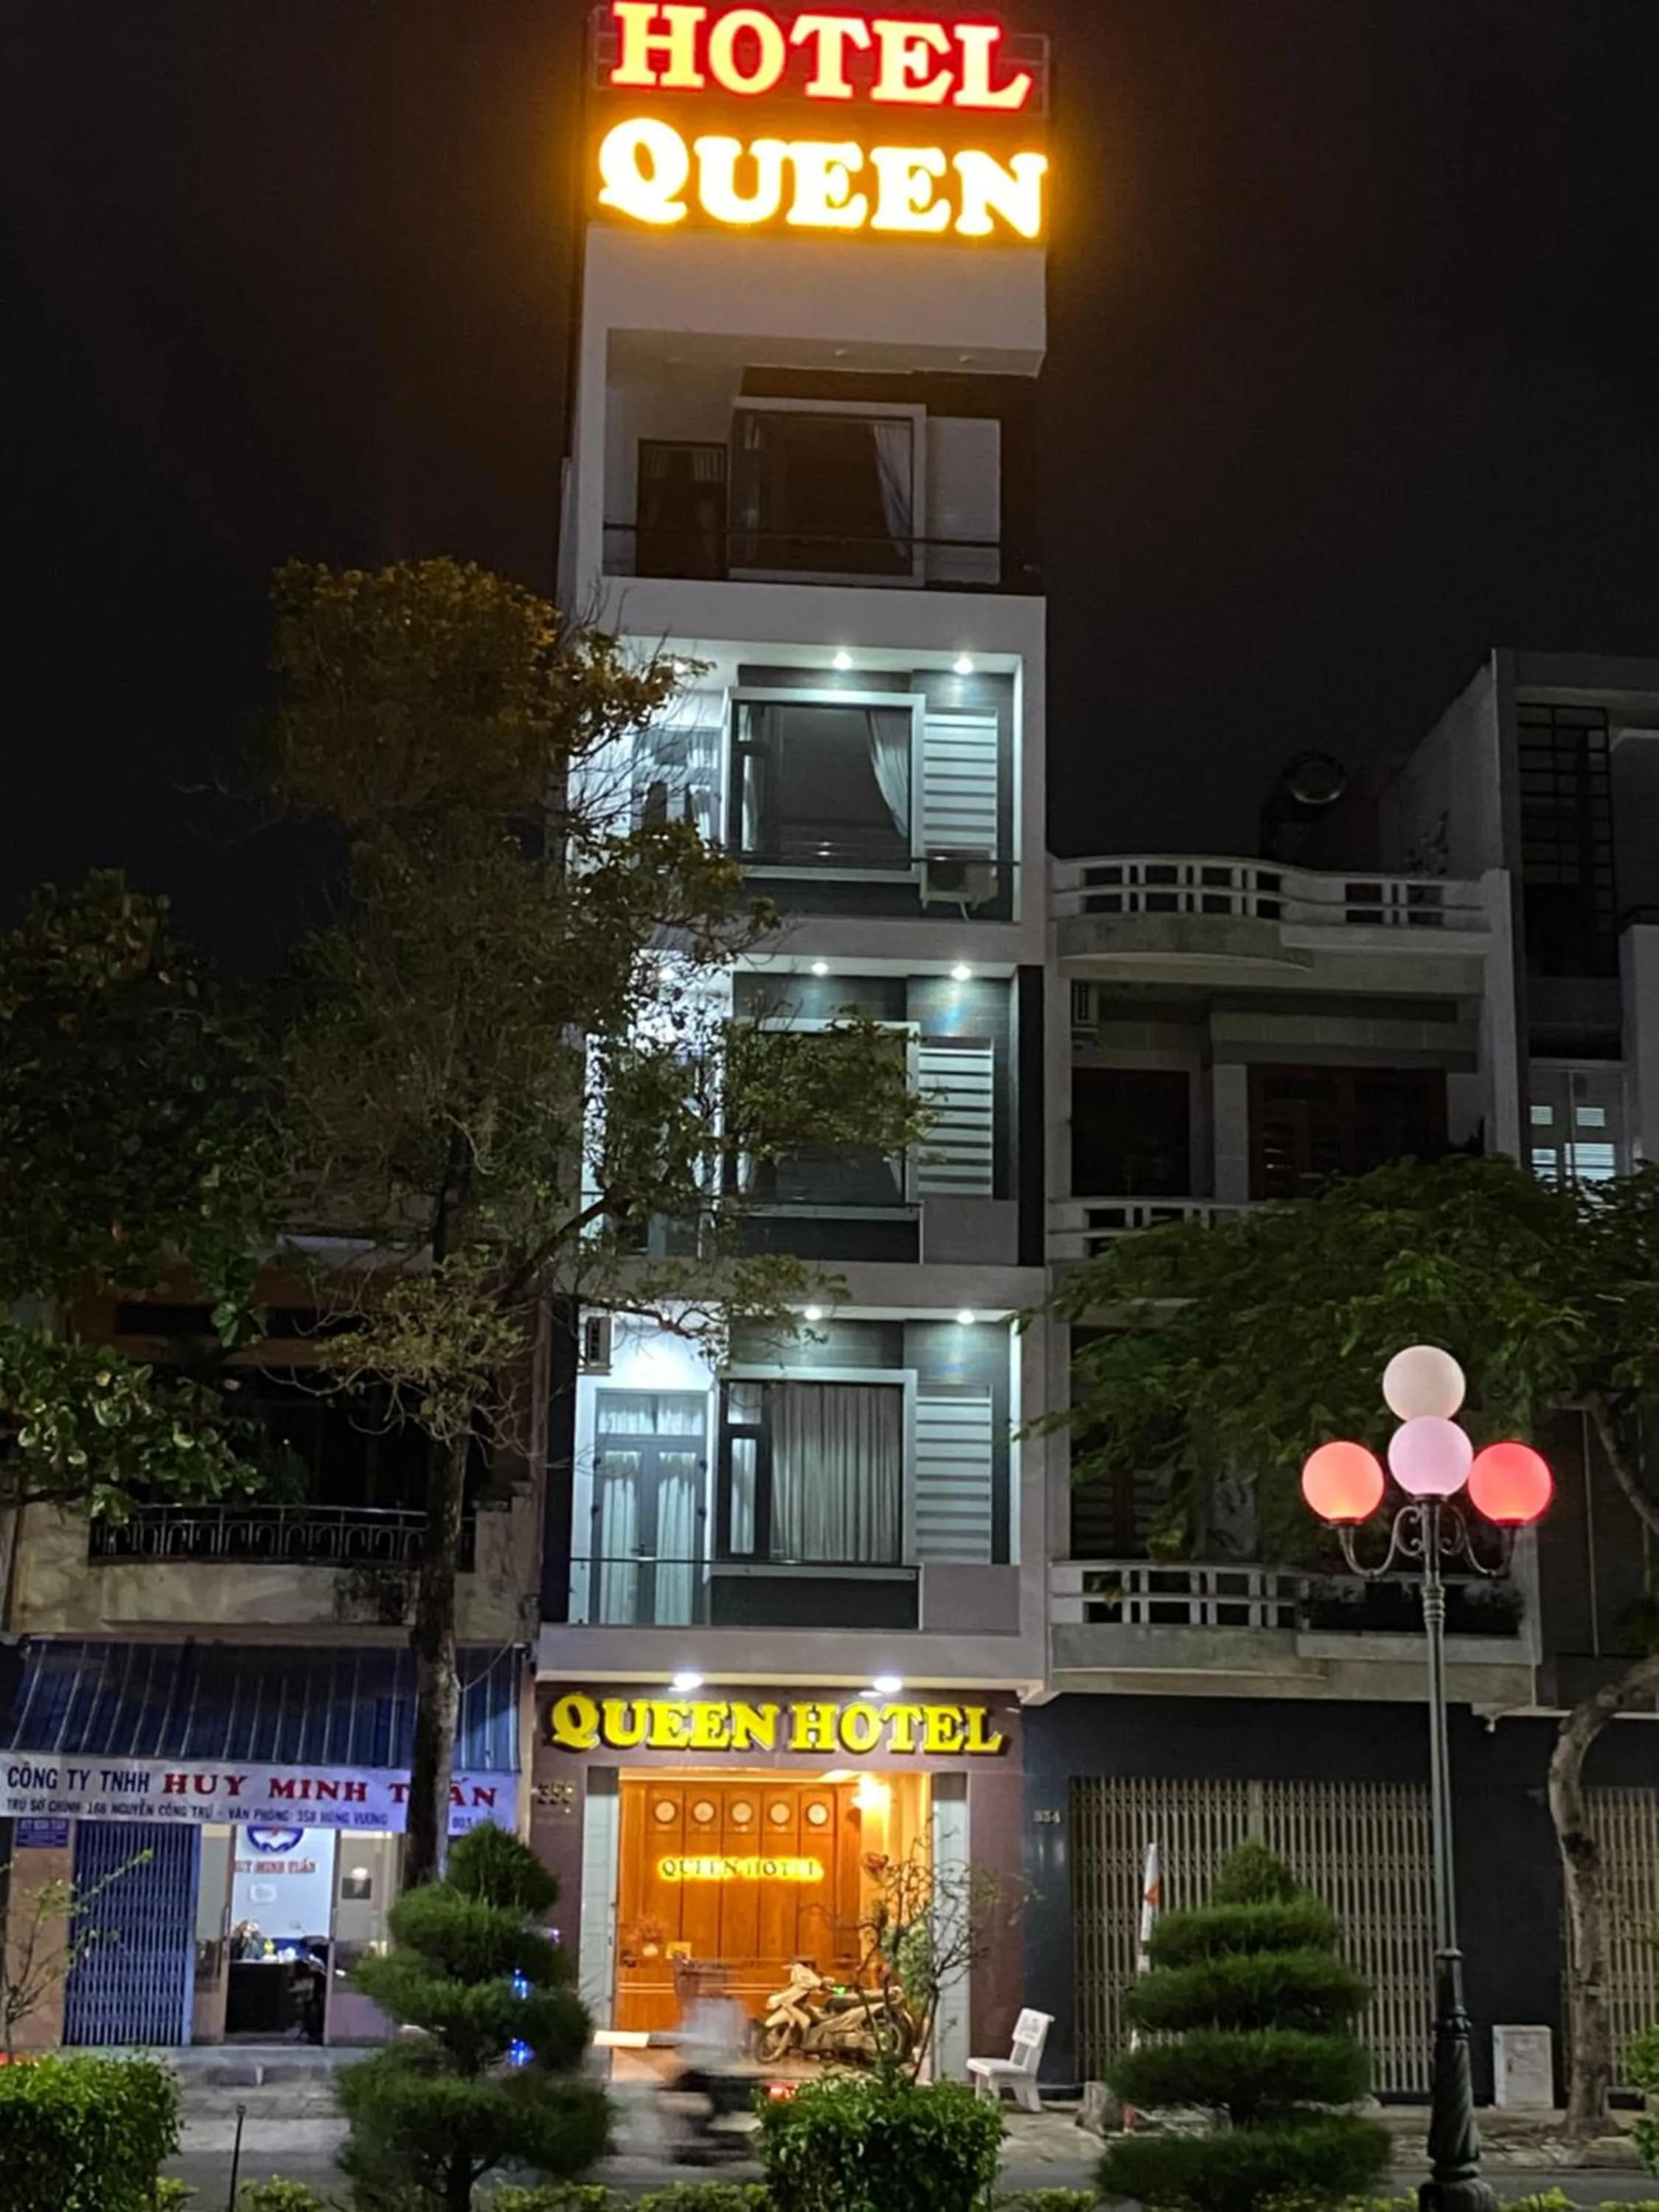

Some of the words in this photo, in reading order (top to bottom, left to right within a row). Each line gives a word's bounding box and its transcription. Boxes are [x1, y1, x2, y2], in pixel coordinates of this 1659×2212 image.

[611, 1, 1032, 110] HOTEL
[598, 116, 1048, 238] QUEEN
[551, 1693, 780, 1750] QUEEN
[788, 1700, 1006, 1755] HOTEL
[7, 1762, 58, 1790] CÔNG
[68, 1769, 91, 1792] TY
[101, 1770, 150, 1794] TNHH
[162, 1773, 248, 1796] HUY
[268, 1777, 368, 1804] MINH
[389, 1777, 498, 1808] TẤN
